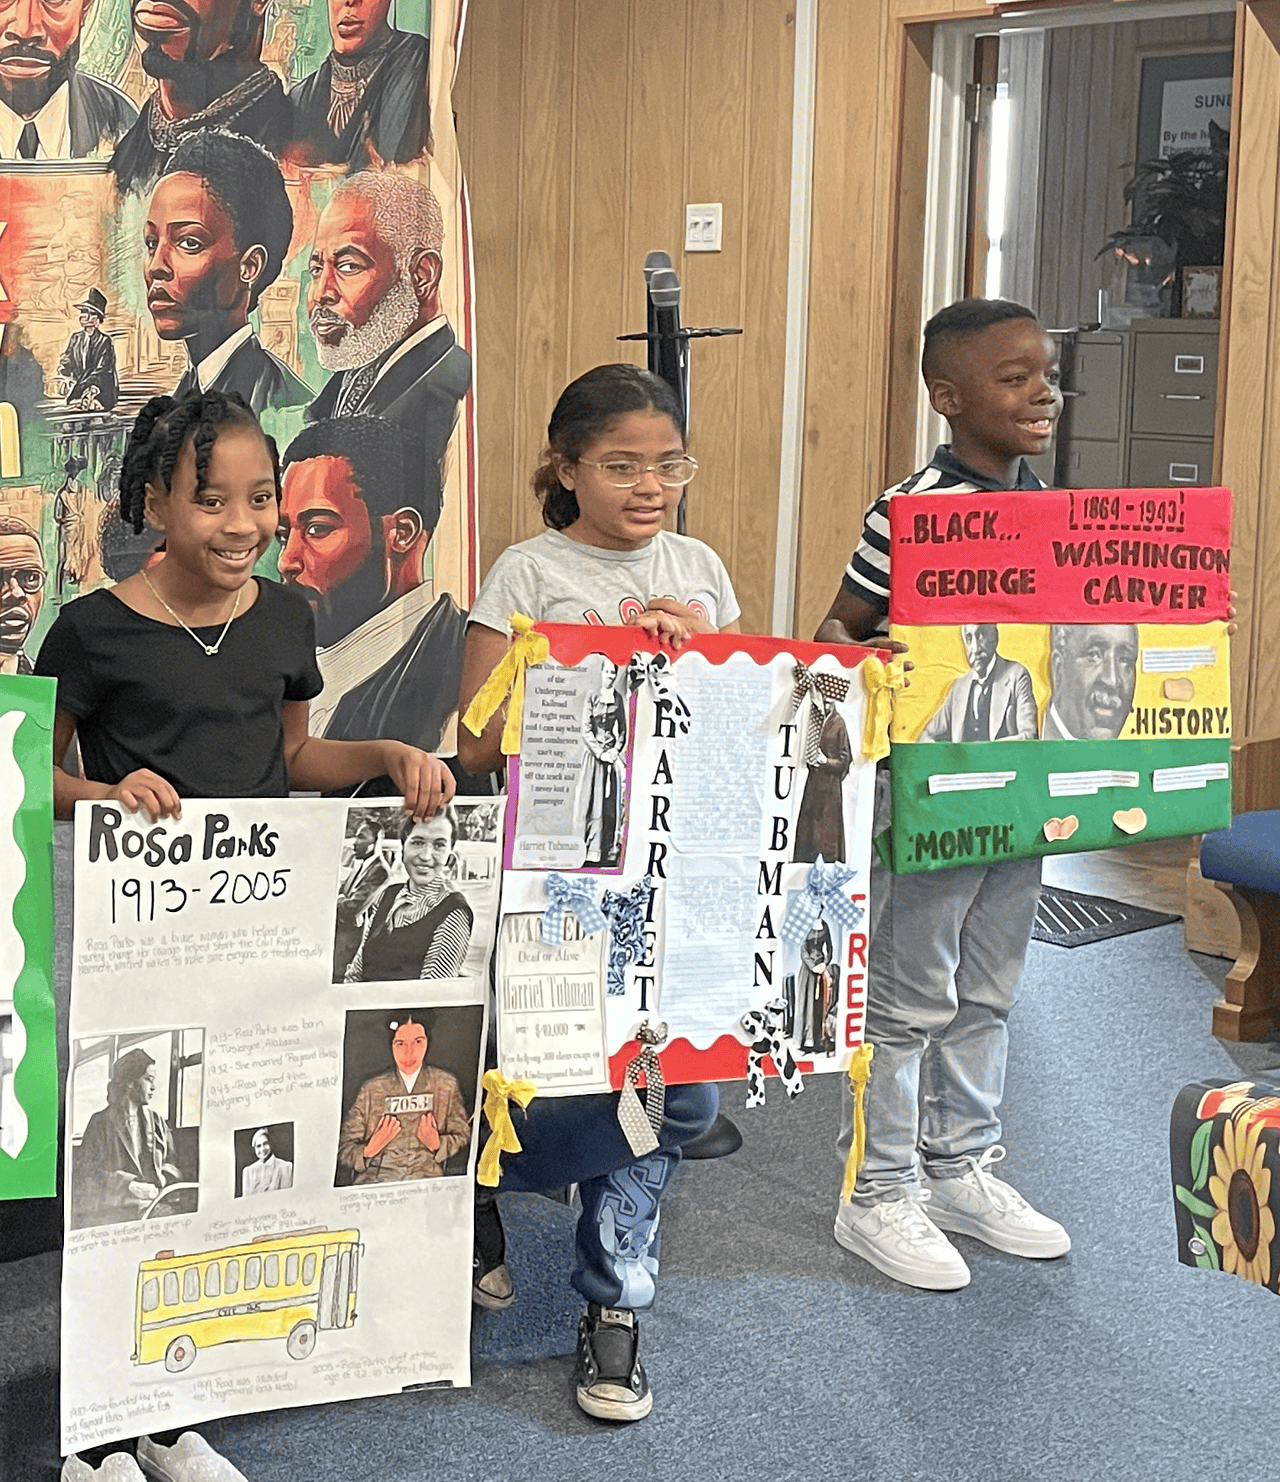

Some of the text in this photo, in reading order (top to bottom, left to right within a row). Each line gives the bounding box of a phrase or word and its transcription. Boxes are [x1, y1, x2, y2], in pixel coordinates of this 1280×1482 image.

[1164, 131, 1177, 143] By
[1180, 131, 1197, 140] the
[916, 539, 1231, 597] GEORGE WASHINGTON
[1084, 574, 1208, 609] CARVER
[89, 804, 193, 868] Rosa
[519, 840, 579, 851] Harriet Tubman
[634, 700, 676, 1012] HARRIET
[753, 723, 798, 987] TUBMAN
[111, 869, 291, 924] 1913-2005
[505, 915, 594, 943] WAED
[542, 953, 552, 962] or
[555, 950, 580, 962] Alive
[503, 975, 595, 1011] Harriet Tubman
[392, 1096, 428, 1112] 7053
